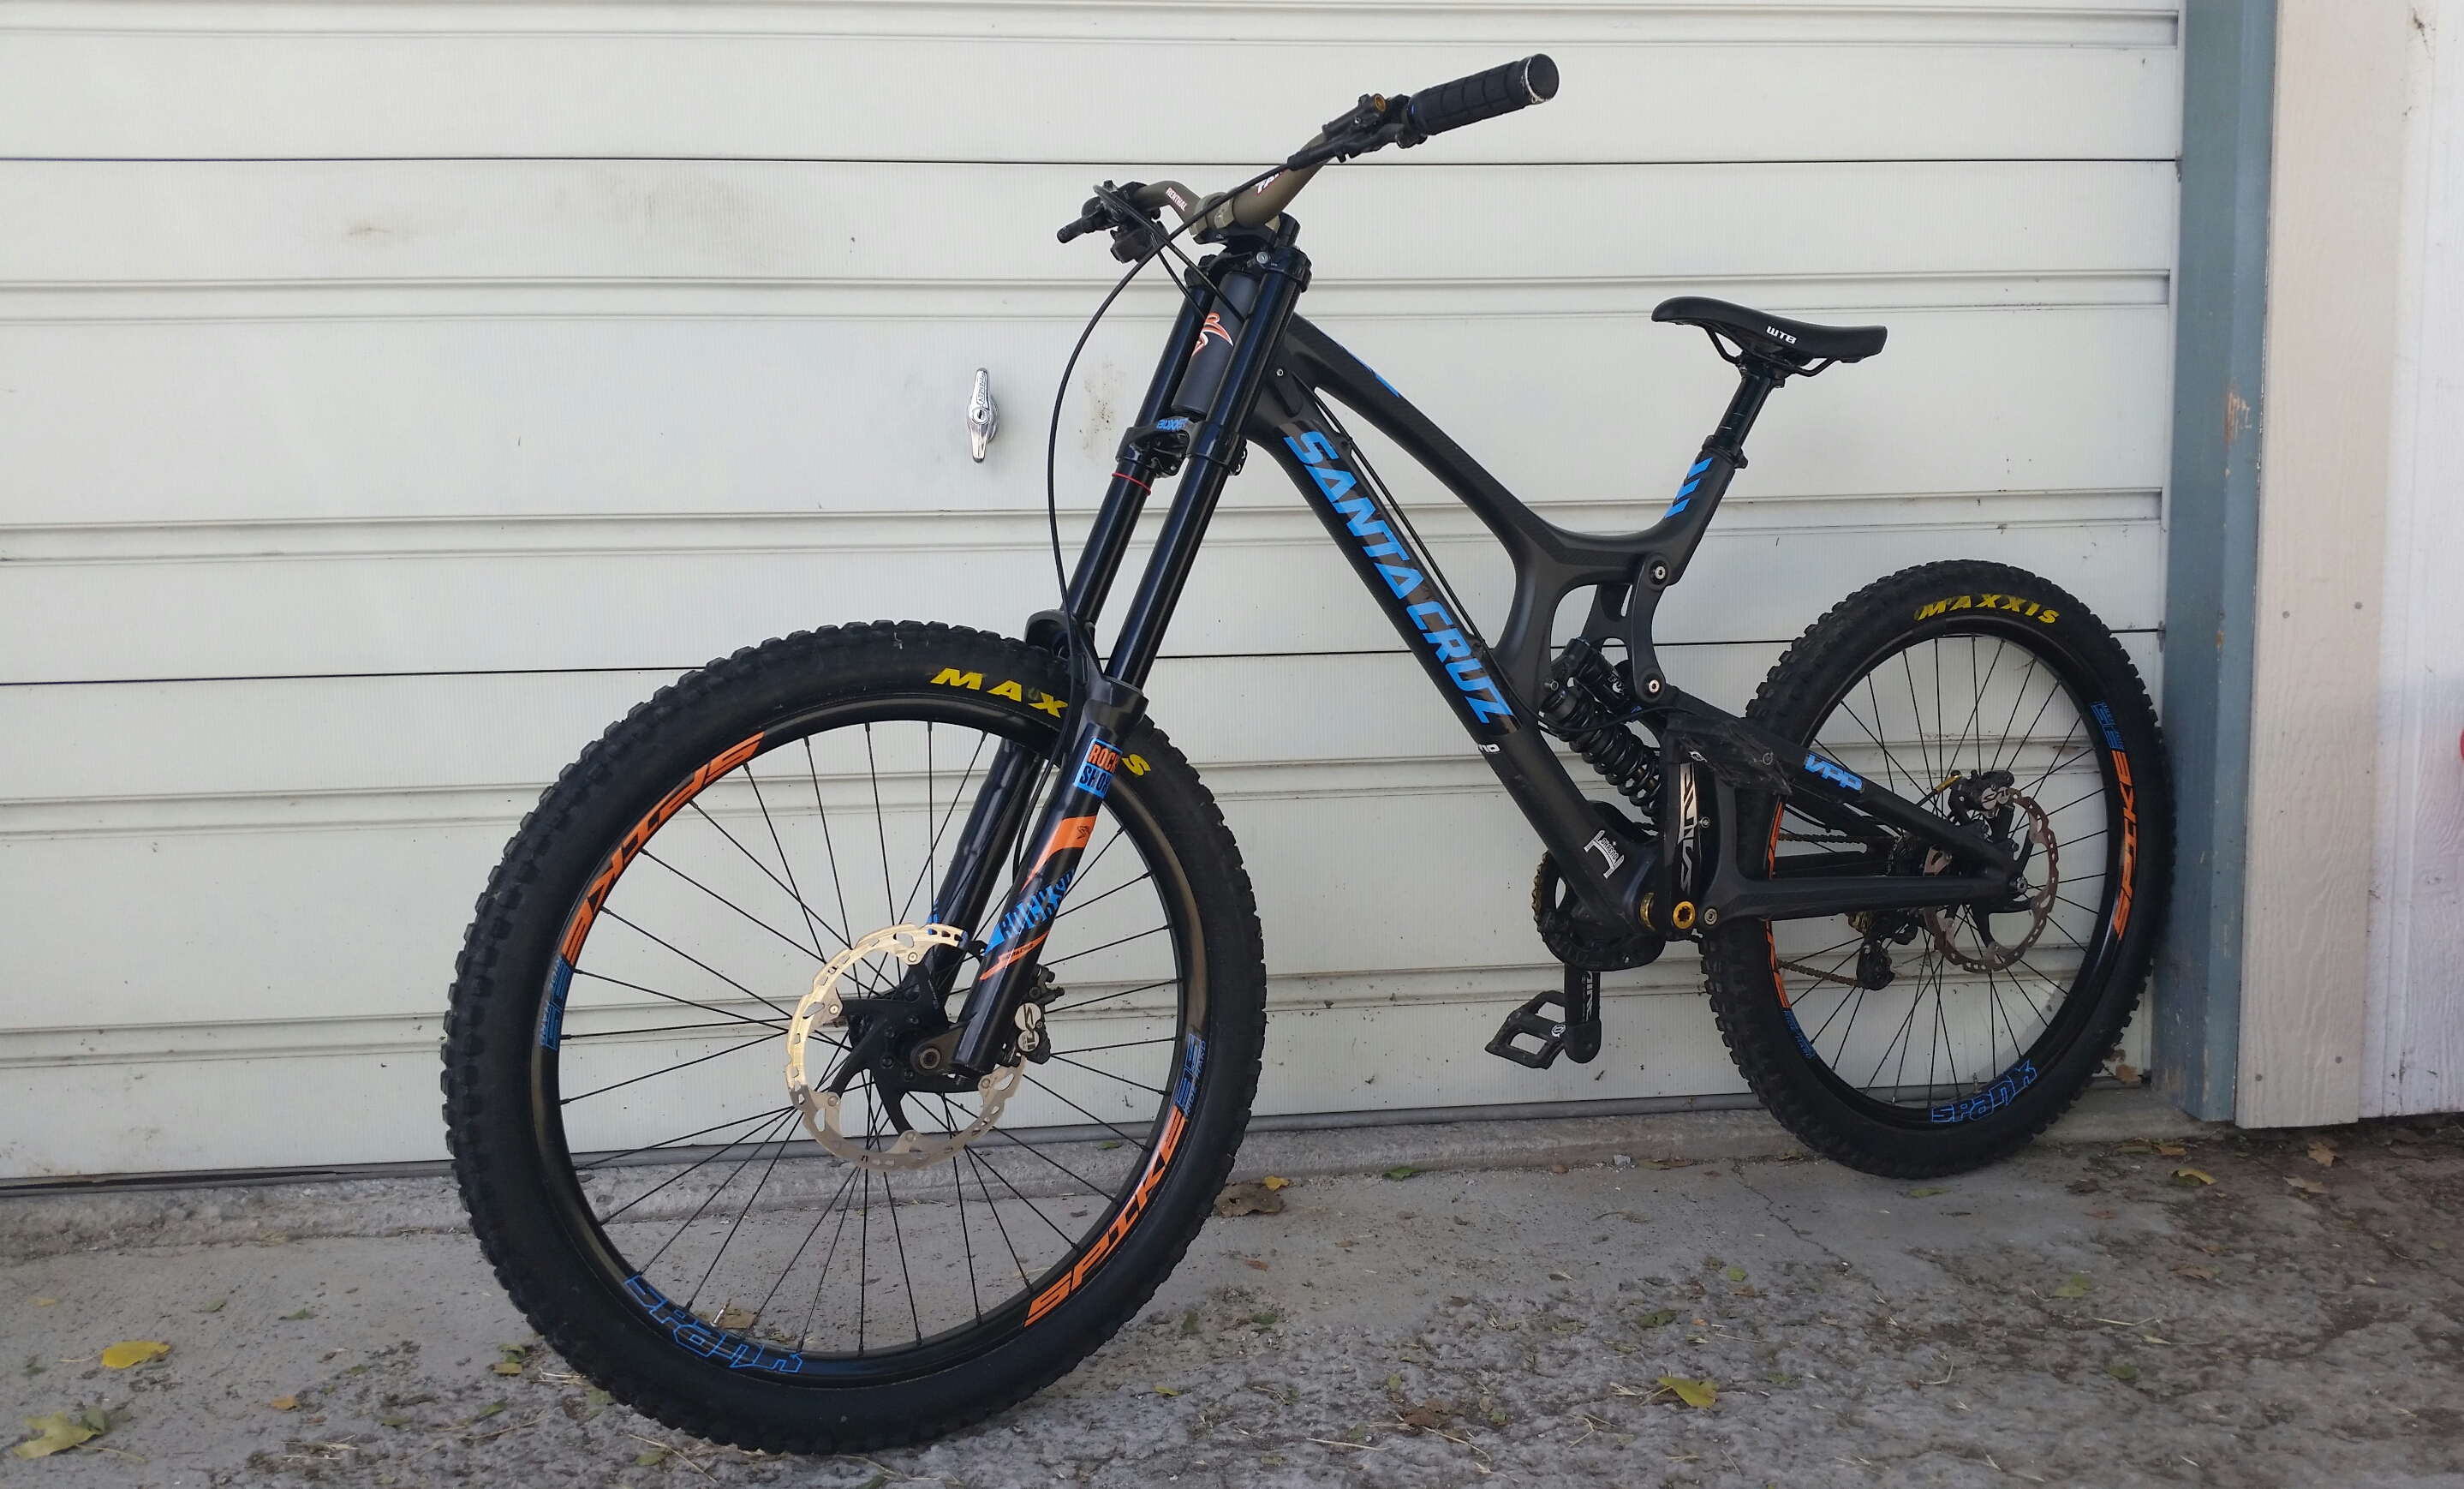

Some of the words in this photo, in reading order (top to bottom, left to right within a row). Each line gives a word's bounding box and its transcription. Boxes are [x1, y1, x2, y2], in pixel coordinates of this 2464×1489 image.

[1166, 188, 1188, 212] RENTHAL
[1766, 326, 1797, 344] WTB
[1285, 431, 1423, 599] SANTA
[1405, 601, 1513, 724] CRUZ
[1917, 593, 2060, 625] MAXXIS
[1087, 743, 1120, 774] ROCK
[1805, 754, 1863, 791] VPP
[1023, 1104, 1188, 1328] SPIKE
